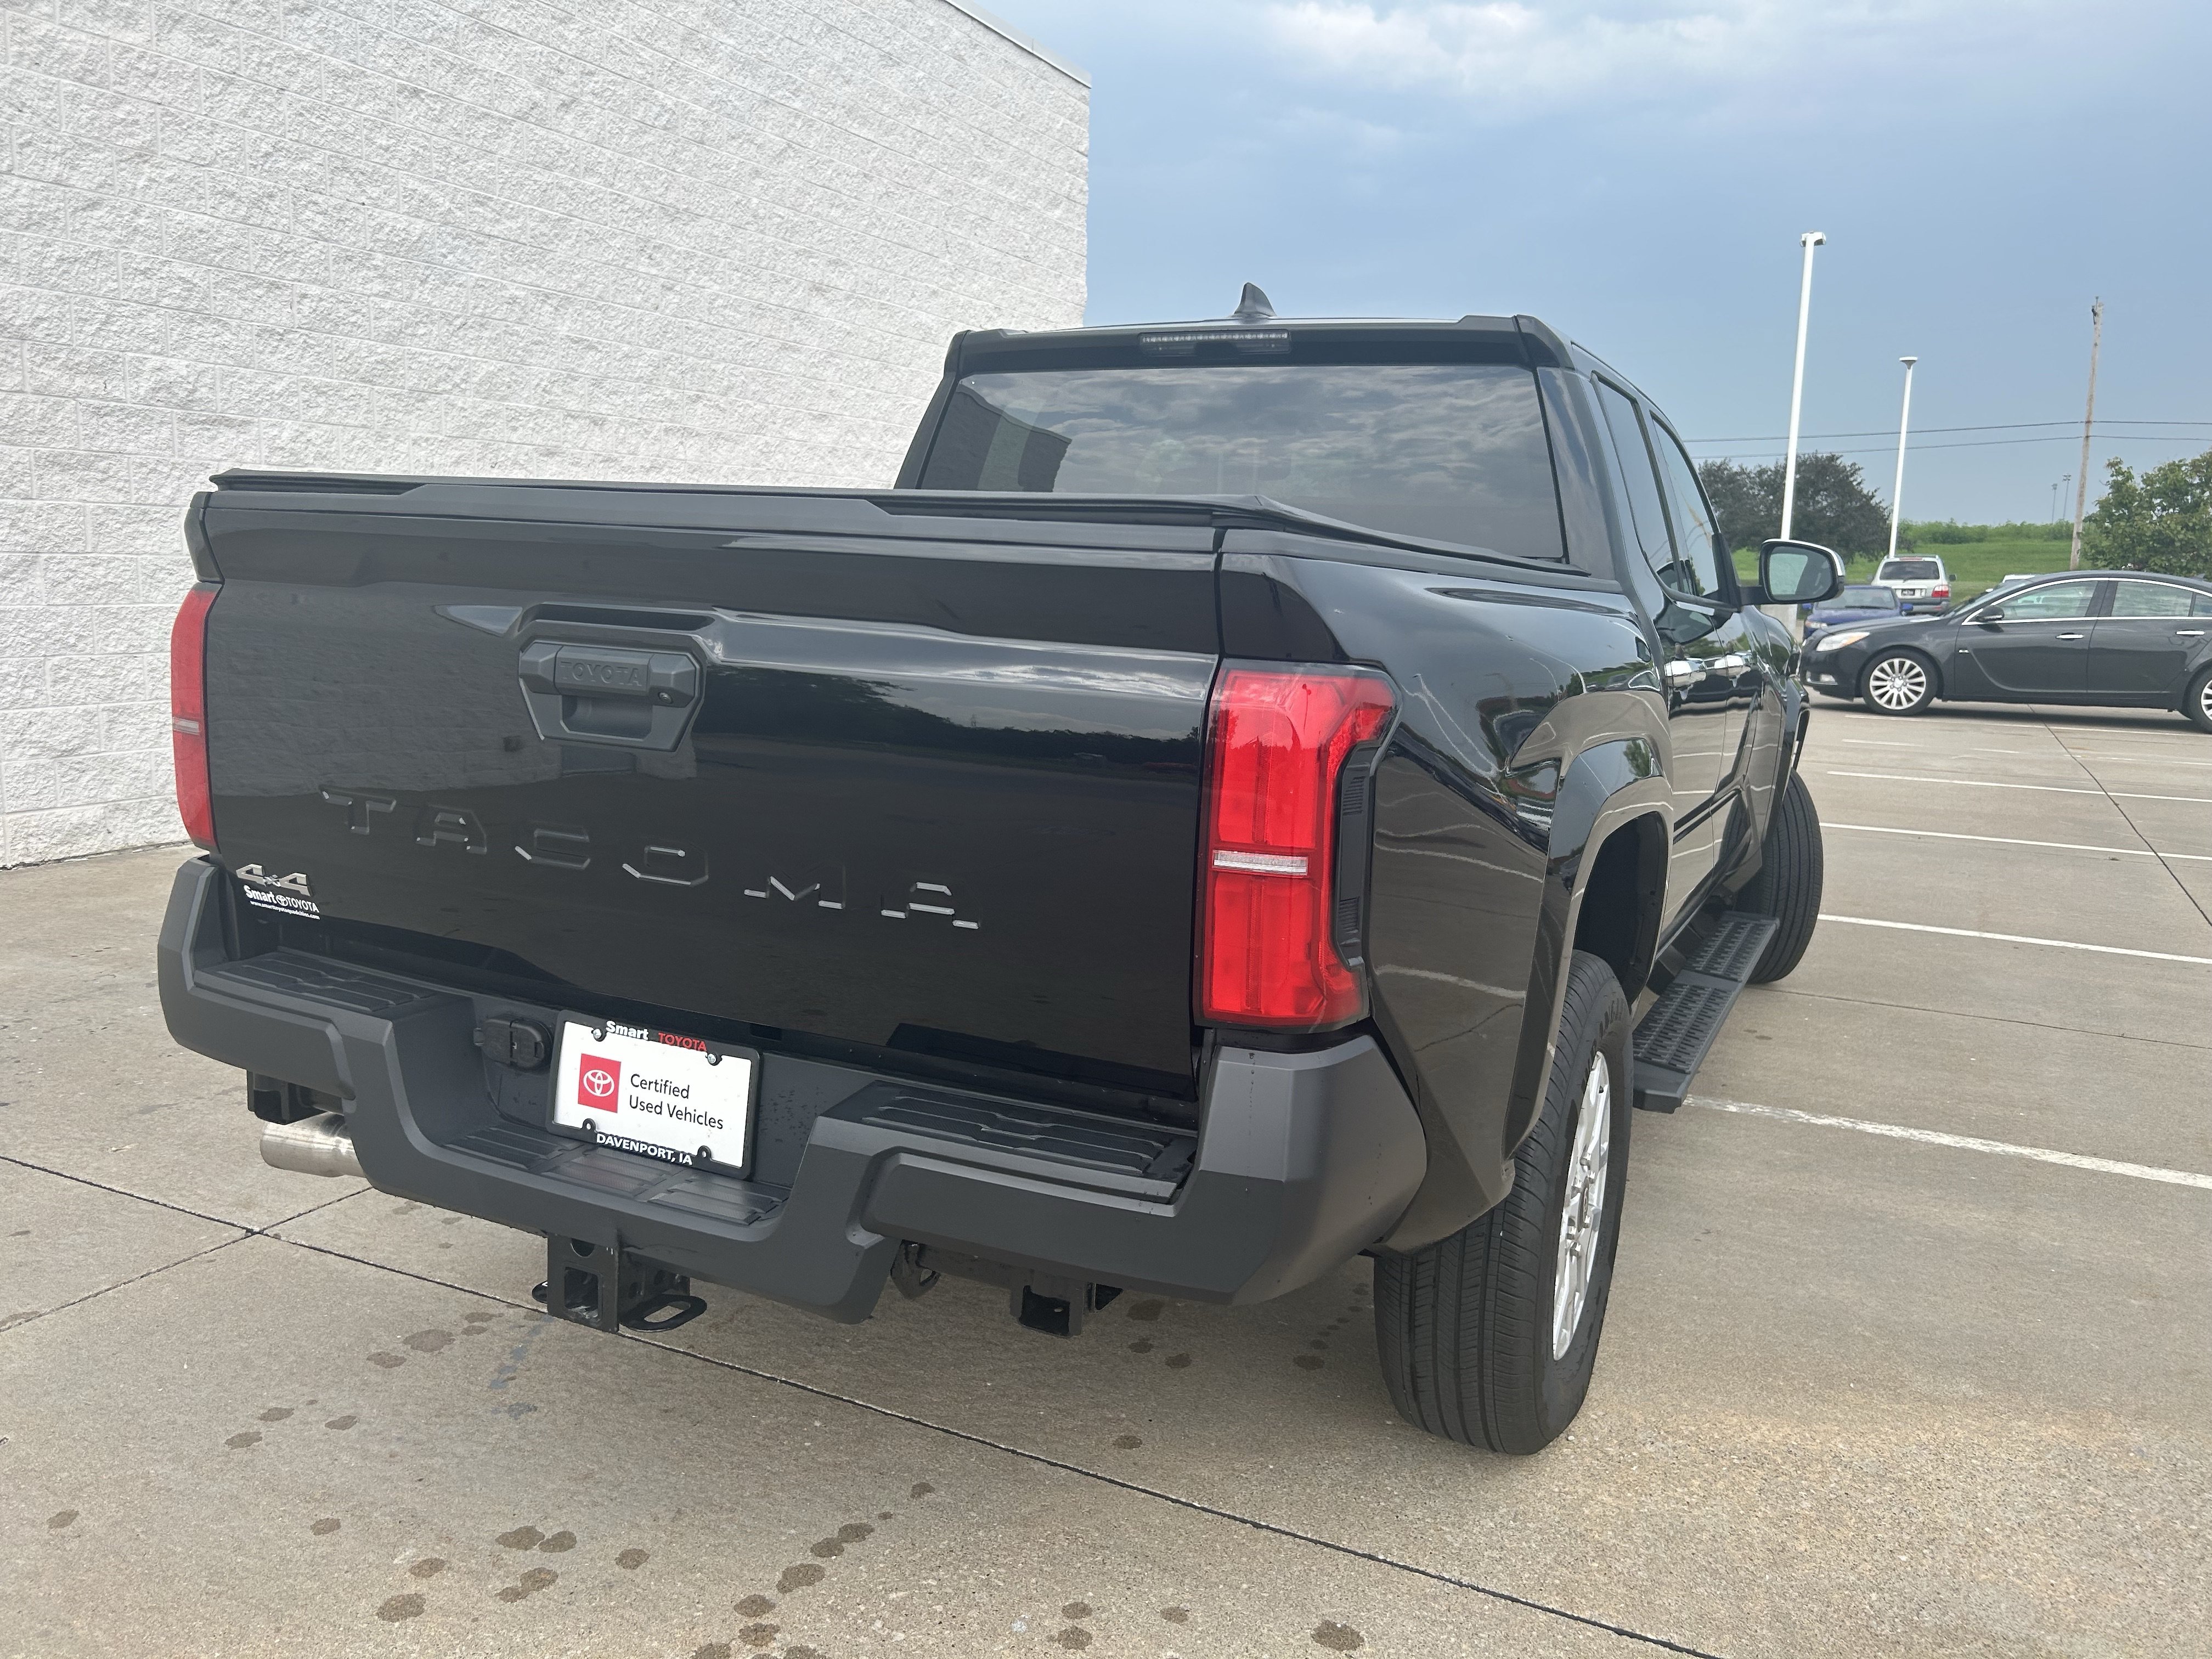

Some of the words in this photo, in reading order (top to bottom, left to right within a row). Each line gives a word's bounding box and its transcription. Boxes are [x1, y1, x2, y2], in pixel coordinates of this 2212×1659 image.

[560, 661, 642, 686] TOYOTA
[319, 785, 980, 929] TACOMA
[244, 884, 276, 905] Smart
[286, 896, 320, 913] TOYOTA
[606, 1020, 649, 1040] Smart
[658, 1032, 707, 1052] TOYOTA
[630, 1074, 690, 1099] Certified
[629, 1095, 663, 1115] Used
[667, 1103, 724, 1130] Vehicles
[596, 1133, 676, 1163] DAVENPORT,
[679, 1153, 692, 1165] IA
